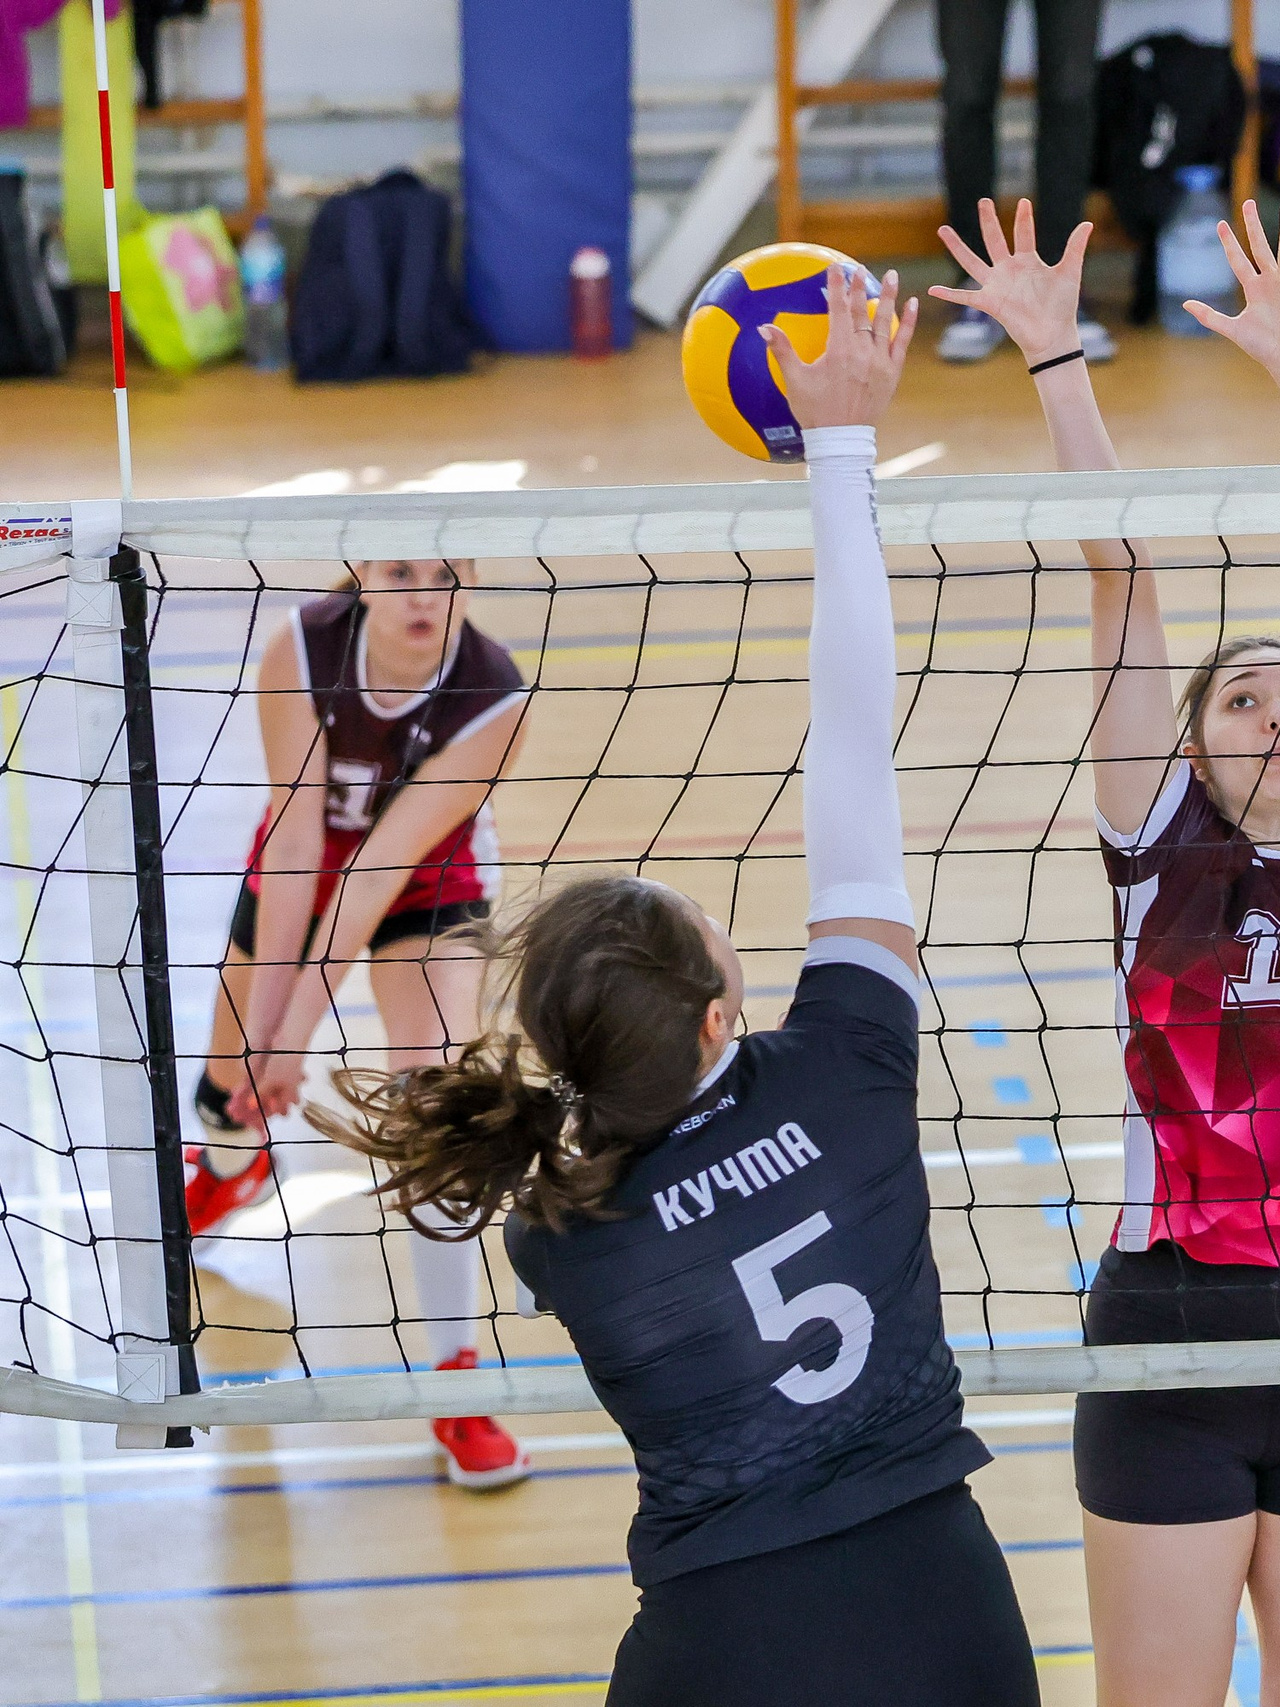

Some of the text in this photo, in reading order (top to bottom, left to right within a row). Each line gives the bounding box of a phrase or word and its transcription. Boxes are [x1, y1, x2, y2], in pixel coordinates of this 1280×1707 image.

[0, 526, 60, 540] Rezac
[669, 1094, 736, 1136] EBON
[653, 1122, 822, 1232] КУЧМА
[731, 1210, 875, 1405] 5
